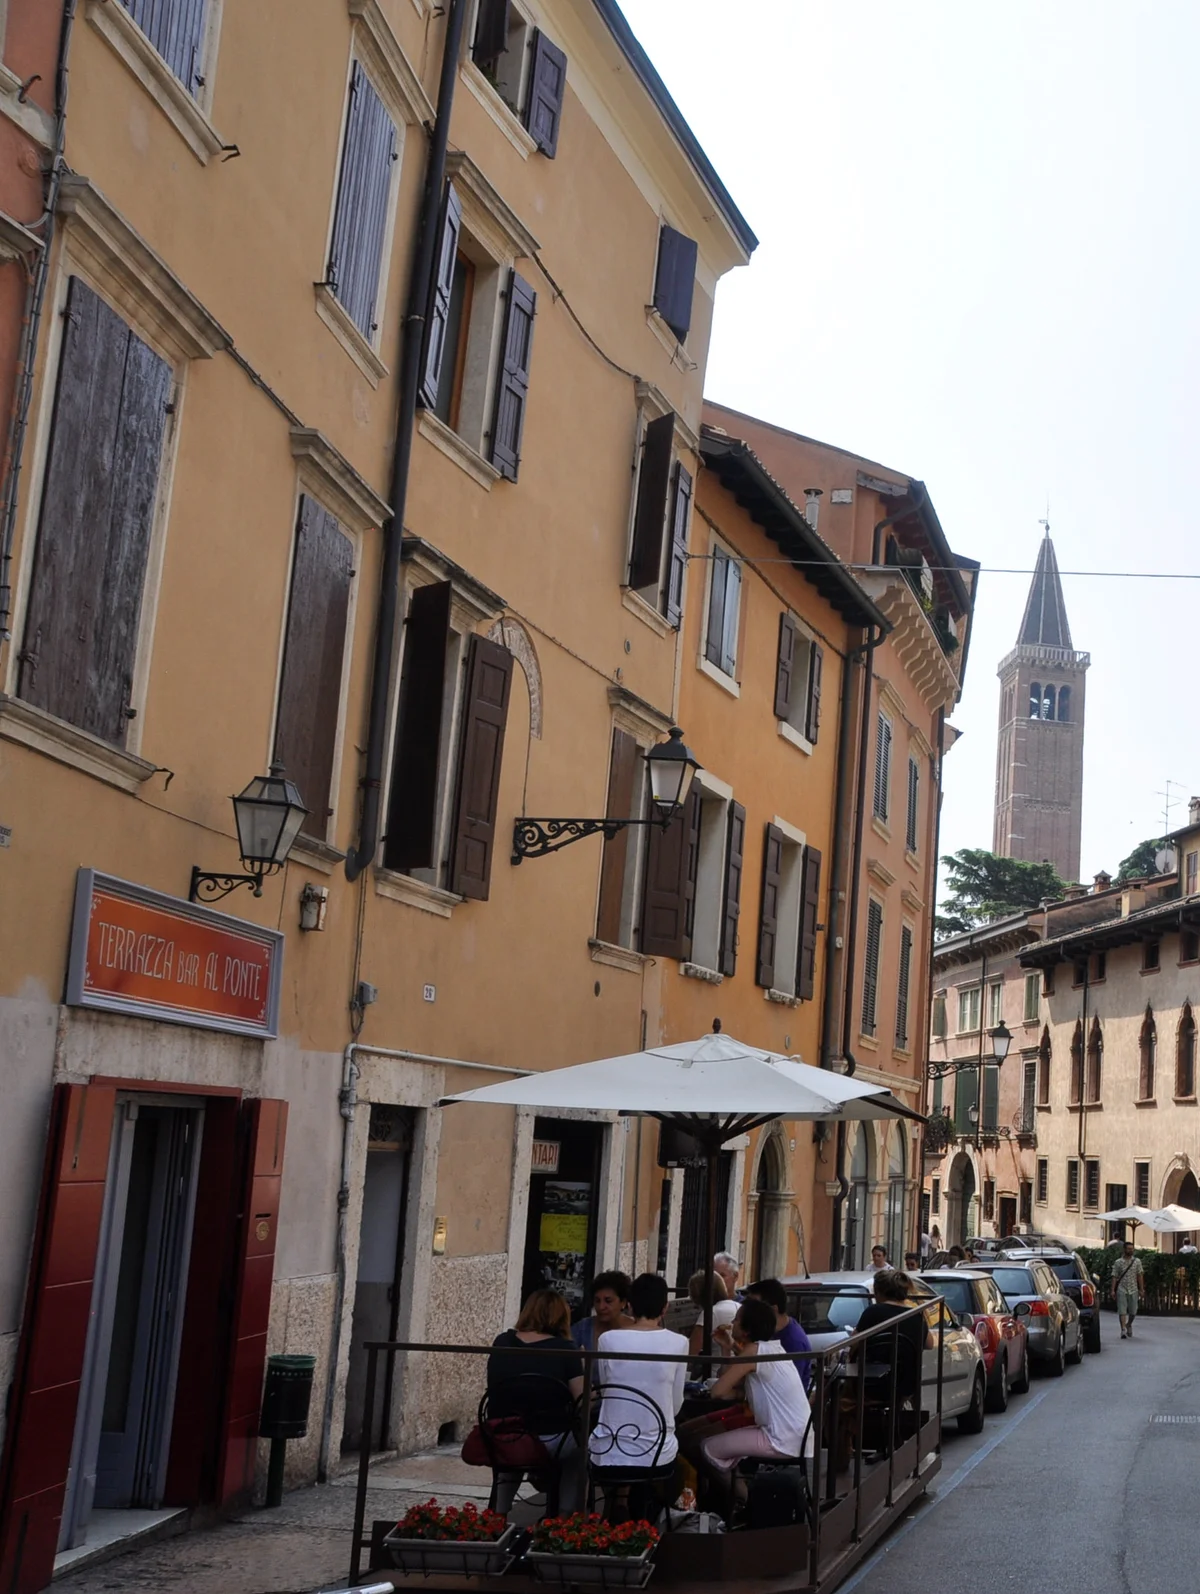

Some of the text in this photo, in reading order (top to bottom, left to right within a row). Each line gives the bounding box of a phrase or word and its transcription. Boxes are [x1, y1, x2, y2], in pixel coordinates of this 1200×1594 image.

[98, 921, 262, 1001] TERRAZZA BAR AL PONTE
